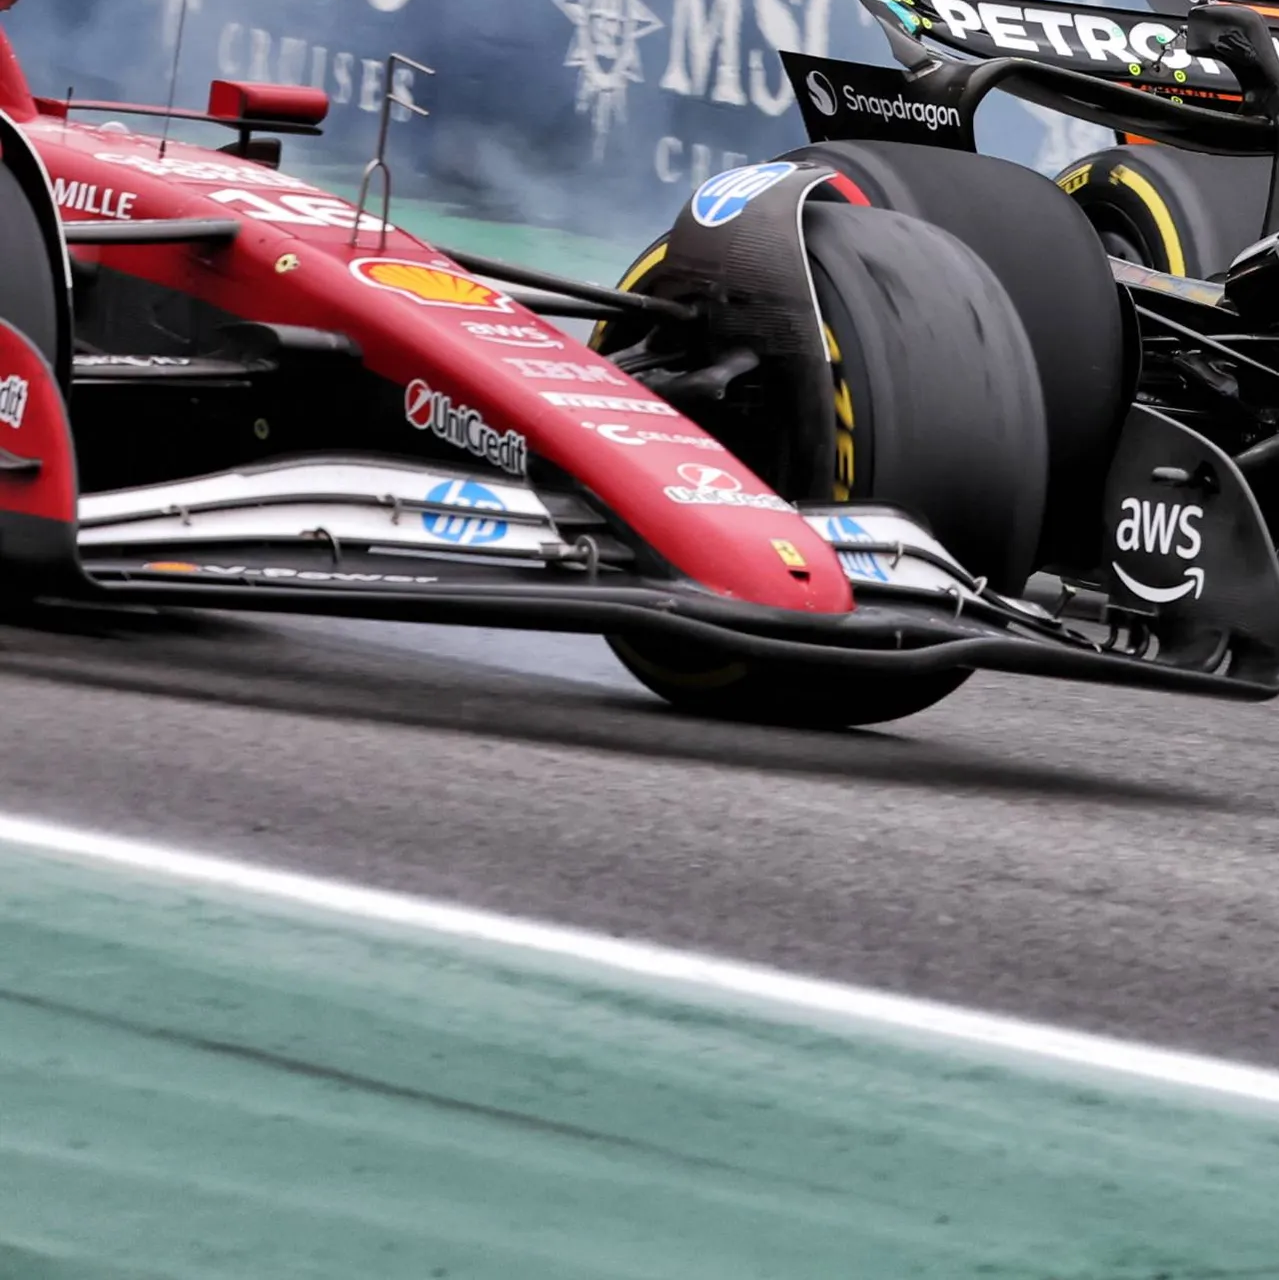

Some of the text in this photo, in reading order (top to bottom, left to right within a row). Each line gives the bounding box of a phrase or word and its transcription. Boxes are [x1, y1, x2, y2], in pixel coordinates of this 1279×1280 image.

[843, 85, 961, 131] Snapdragon
[53, 178, 138, 219] MILLE
[461, 321, 549, 340] aws
[431, 392, 528, 475] UniCredit
[428, 479, 505, 544] hp
[1116, 498, 1203, 559] aws
[203, 565, 439, 583] V-Power
